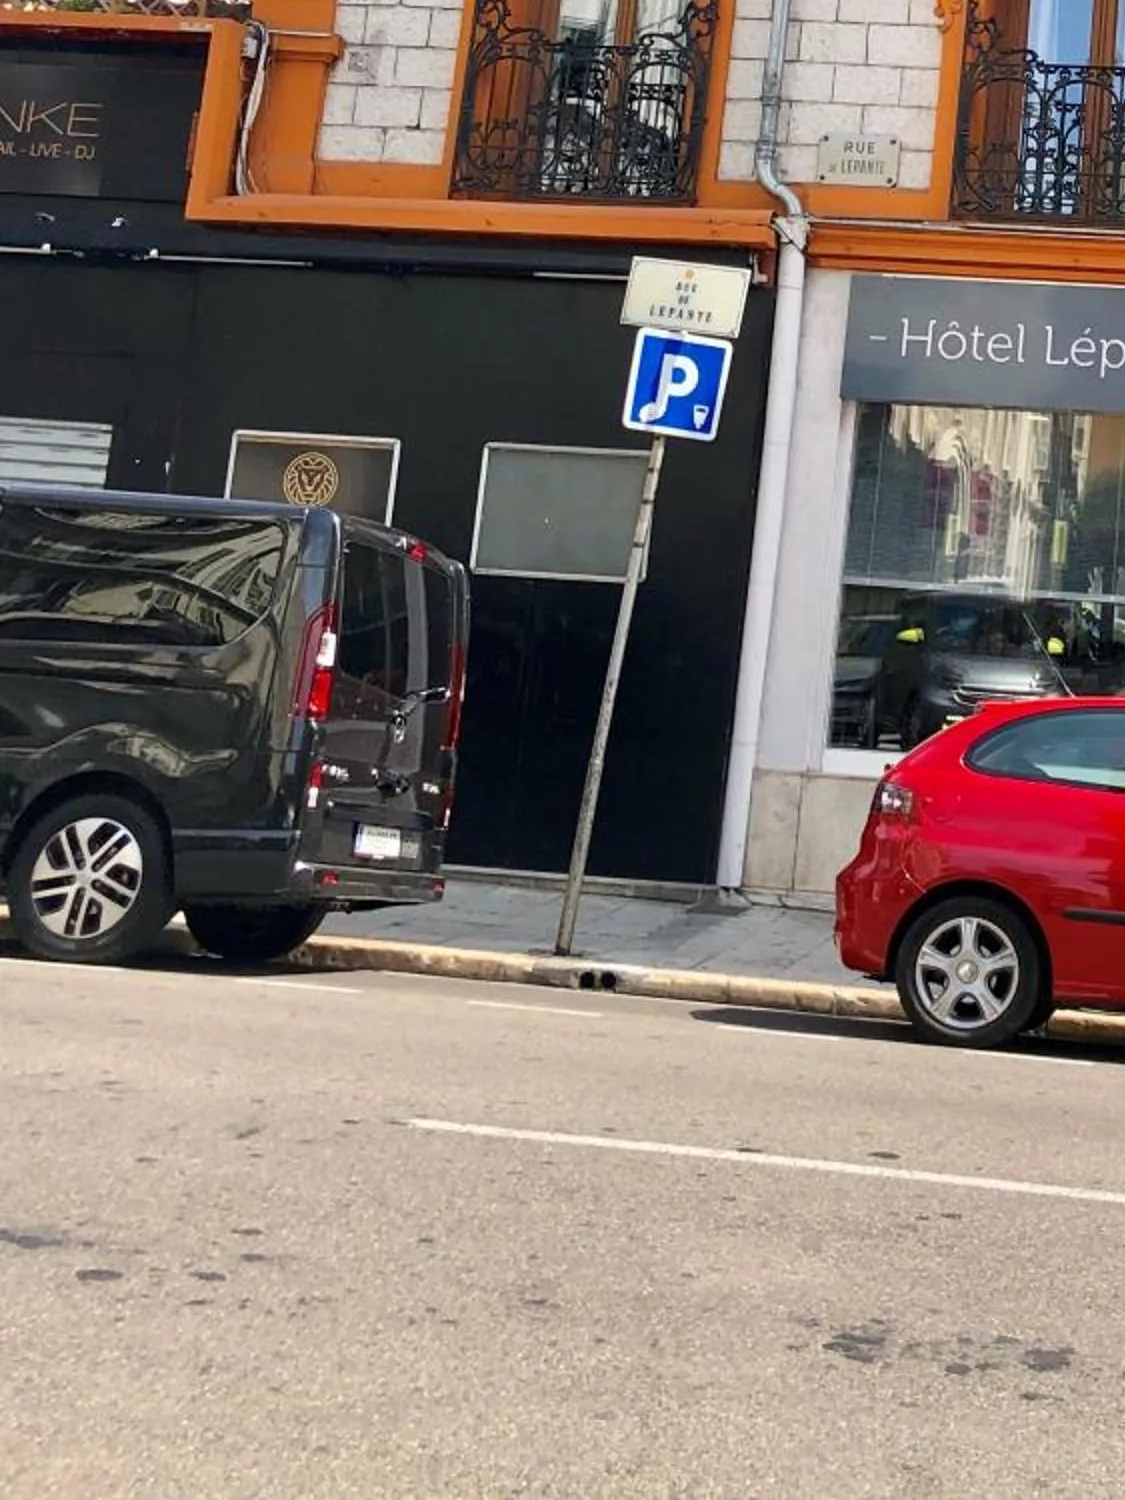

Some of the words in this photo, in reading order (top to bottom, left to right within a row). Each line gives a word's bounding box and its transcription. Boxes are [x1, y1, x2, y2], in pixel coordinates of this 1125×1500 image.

[30, 143, 63, 158] LIVE
[75, 145, 95, 160] DJ
[843, 141, 876, 155] RUE
[900, 318, 1026, 364] Hôtel
